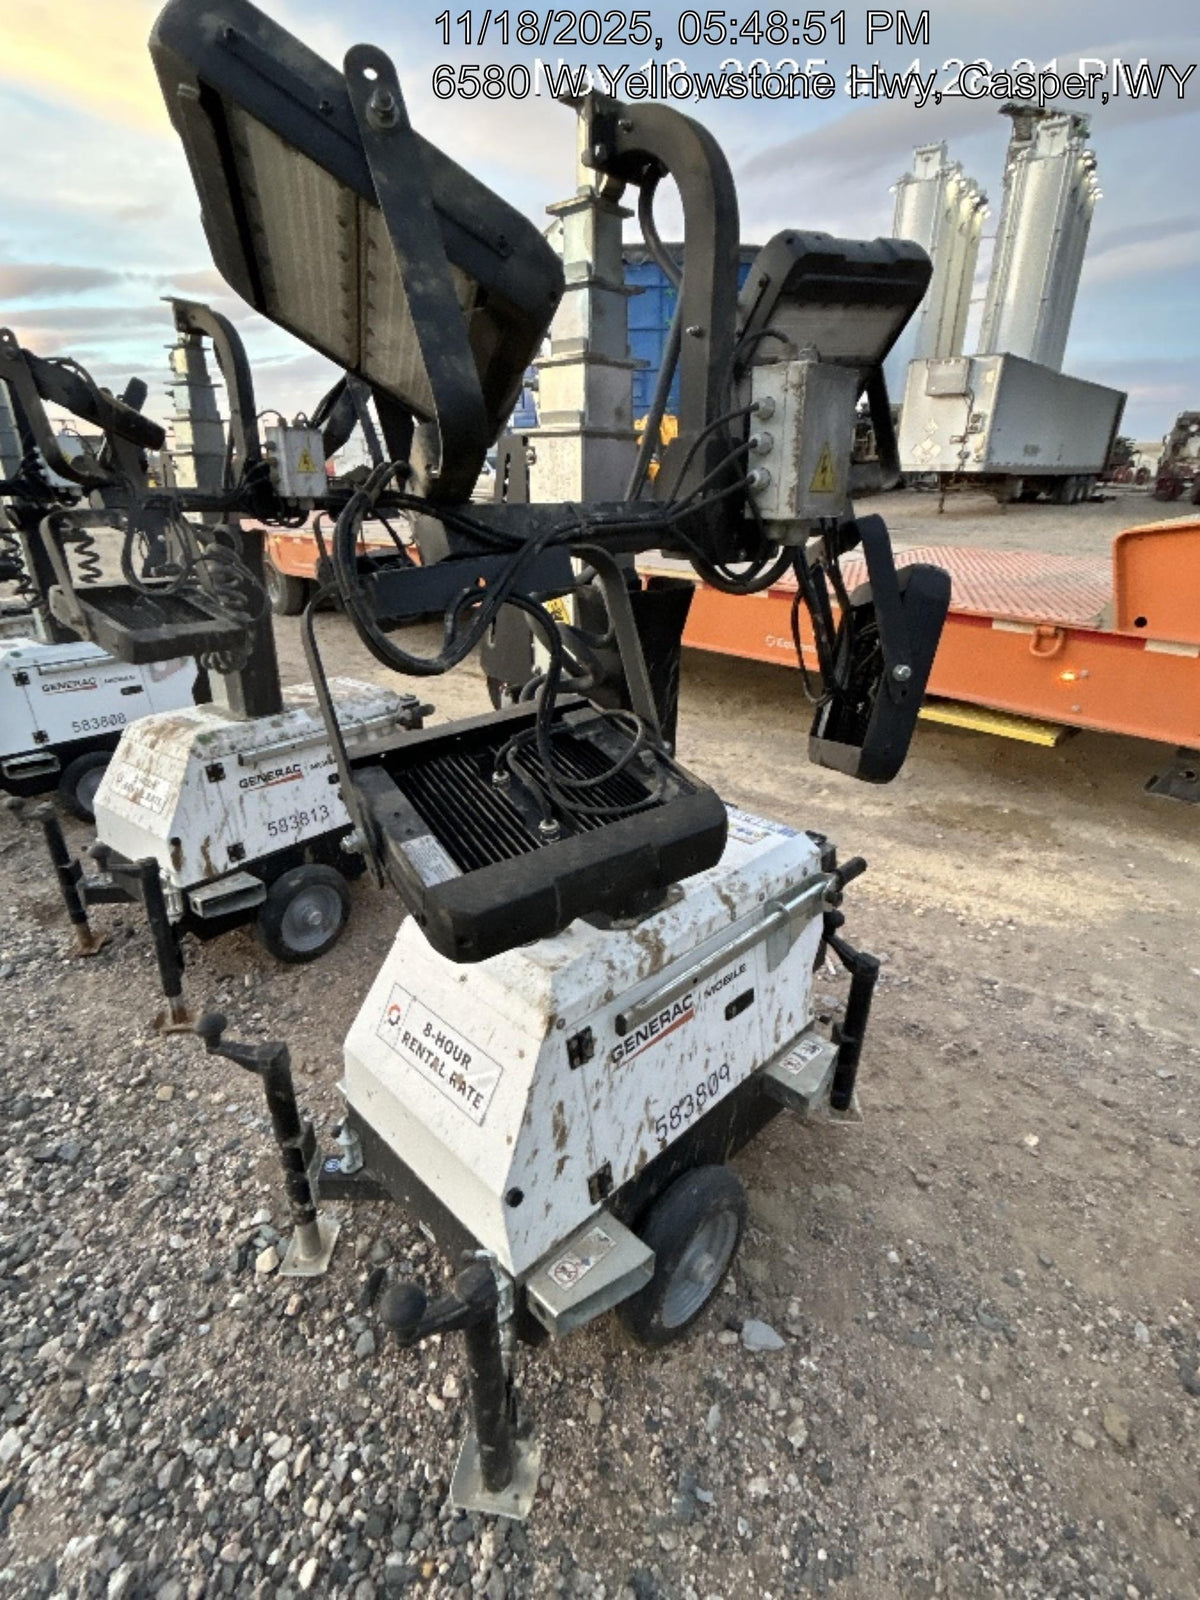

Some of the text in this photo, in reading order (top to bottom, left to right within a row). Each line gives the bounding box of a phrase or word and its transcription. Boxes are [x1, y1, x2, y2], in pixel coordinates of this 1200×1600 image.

[72, 712, 127, 733] 583808
[239, 763, 302, 789] GENERAC
[267, 804, 330, 837] 583813
[610, 963, 747, 1063] GENERAC MOBILE
[401, 1030, 484, 1110] RENTAL RATE
[422, 1021, 472, 1071] 8-HOUR
[655, 1063, 730, 1142] 583809
